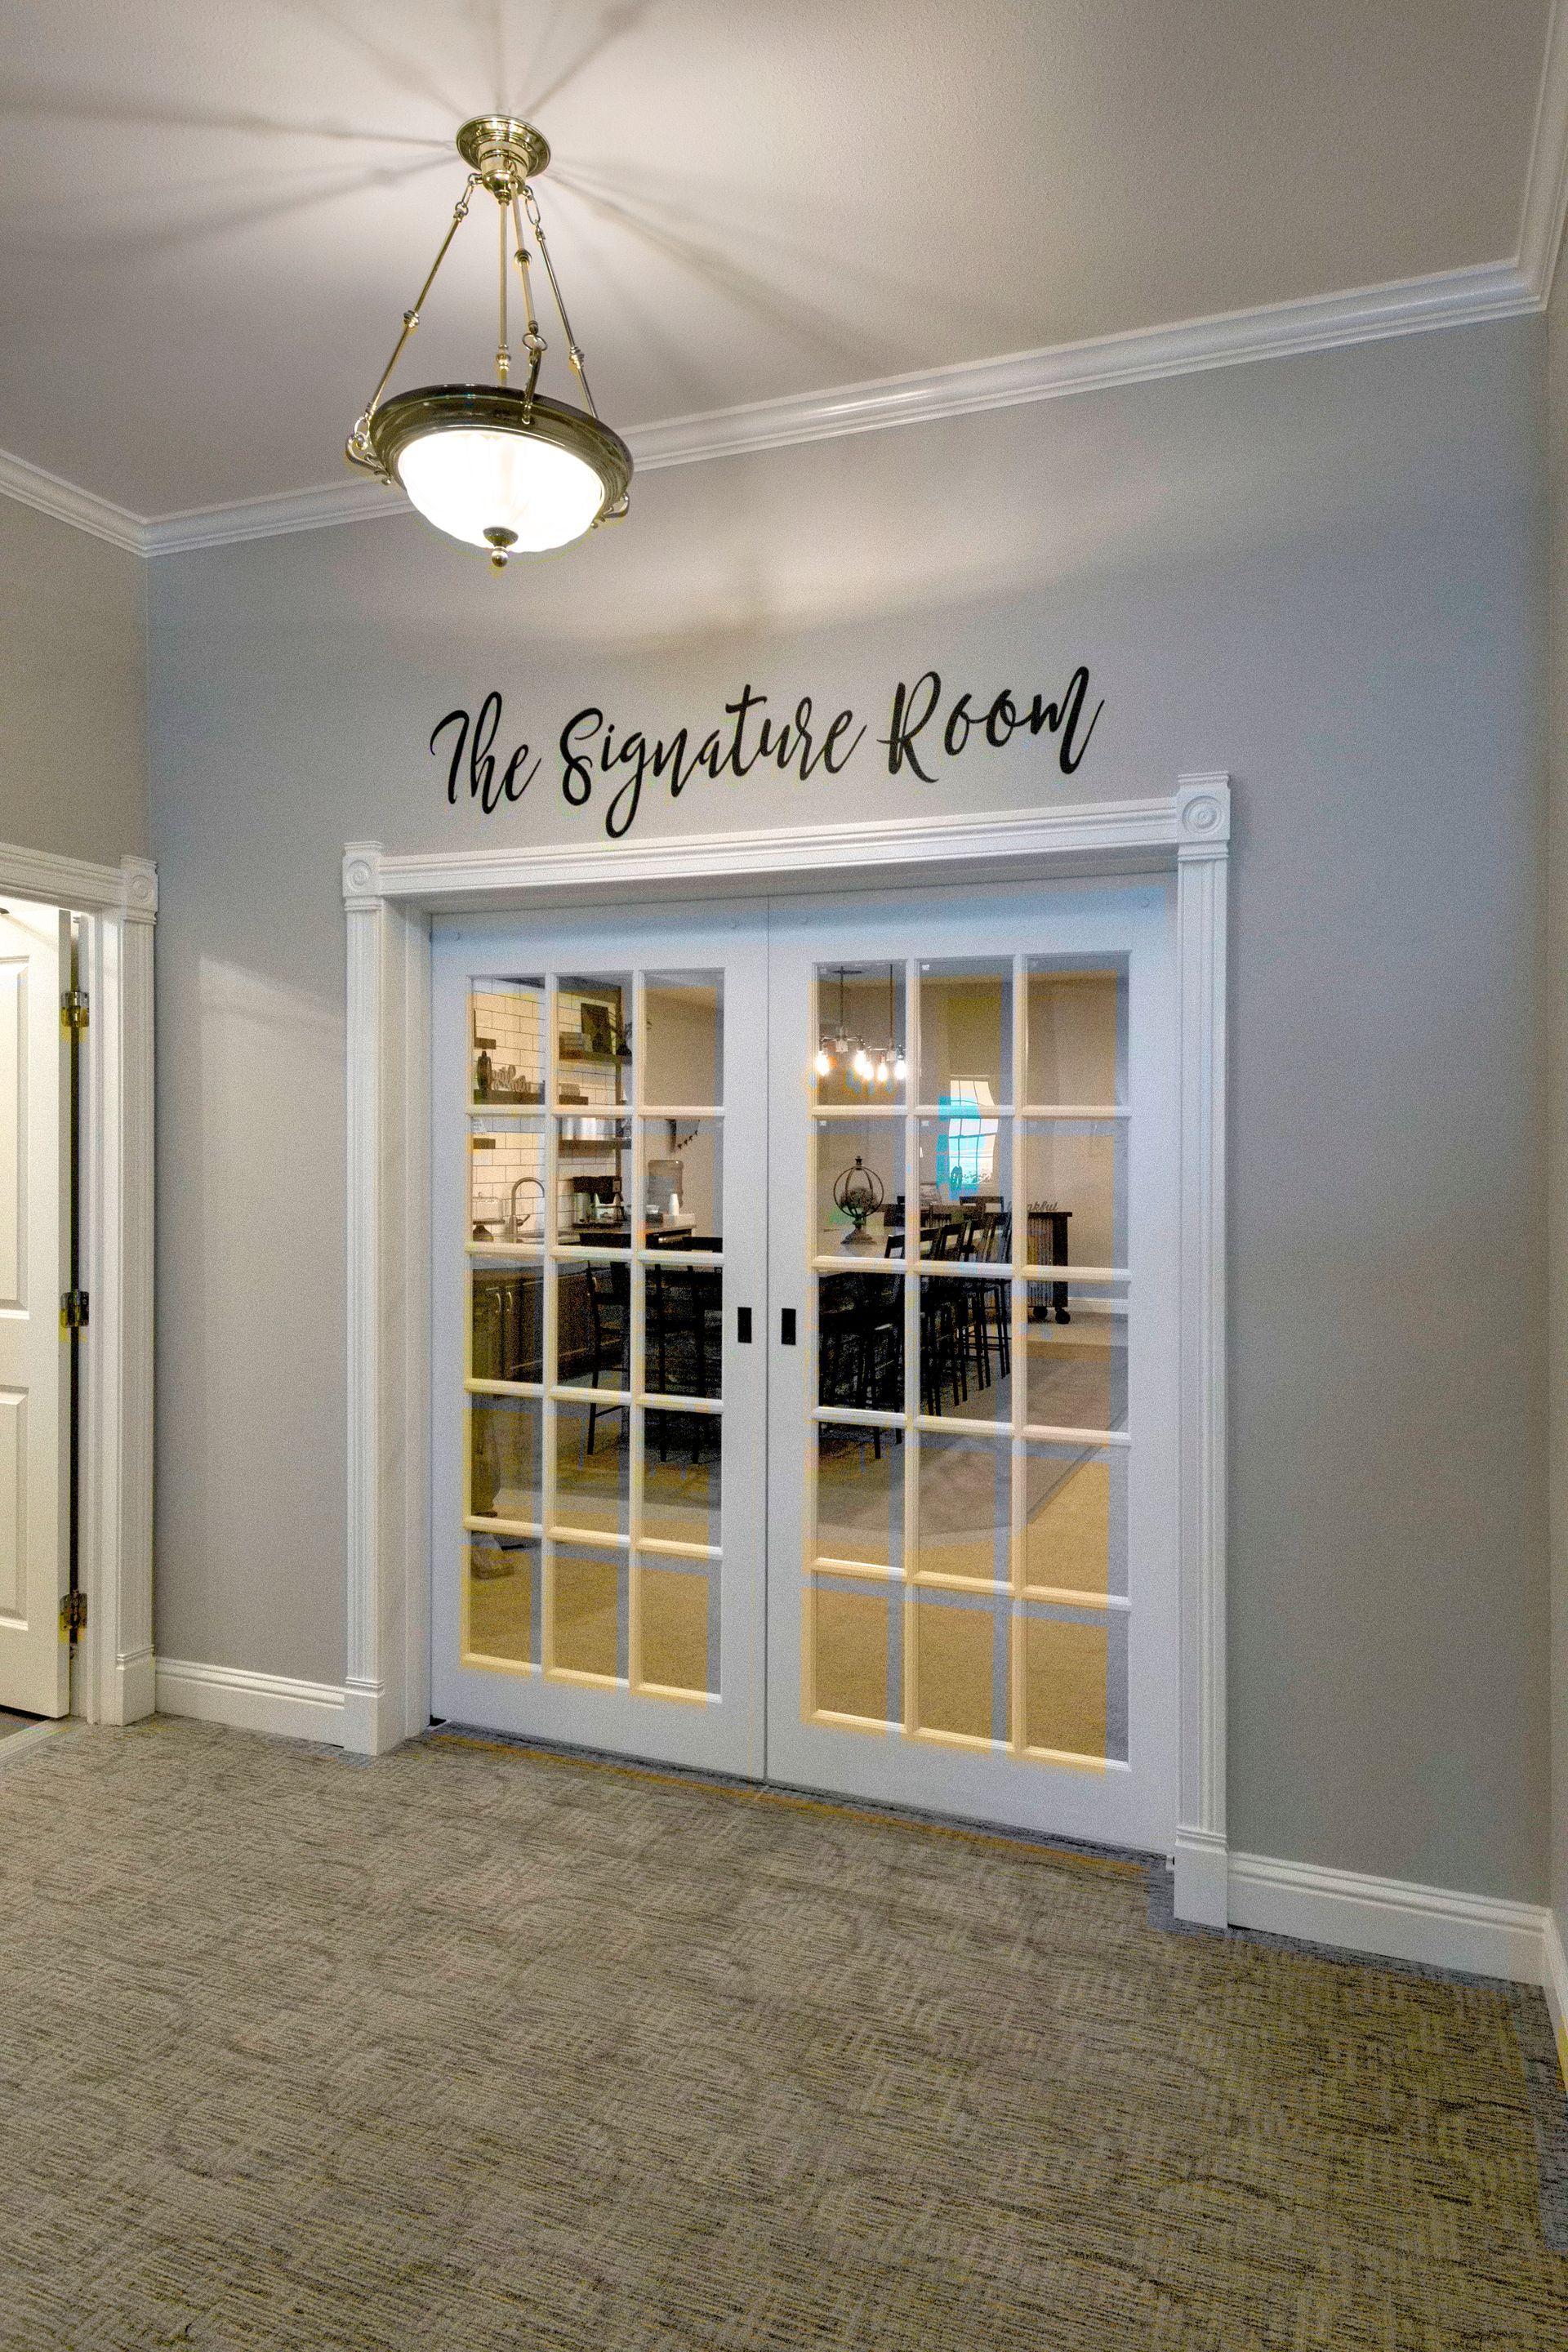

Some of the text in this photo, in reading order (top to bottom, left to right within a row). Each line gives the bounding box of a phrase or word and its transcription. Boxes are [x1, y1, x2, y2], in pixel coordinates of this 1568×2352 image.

[430, 666, 1105, 839] The Signature Room
